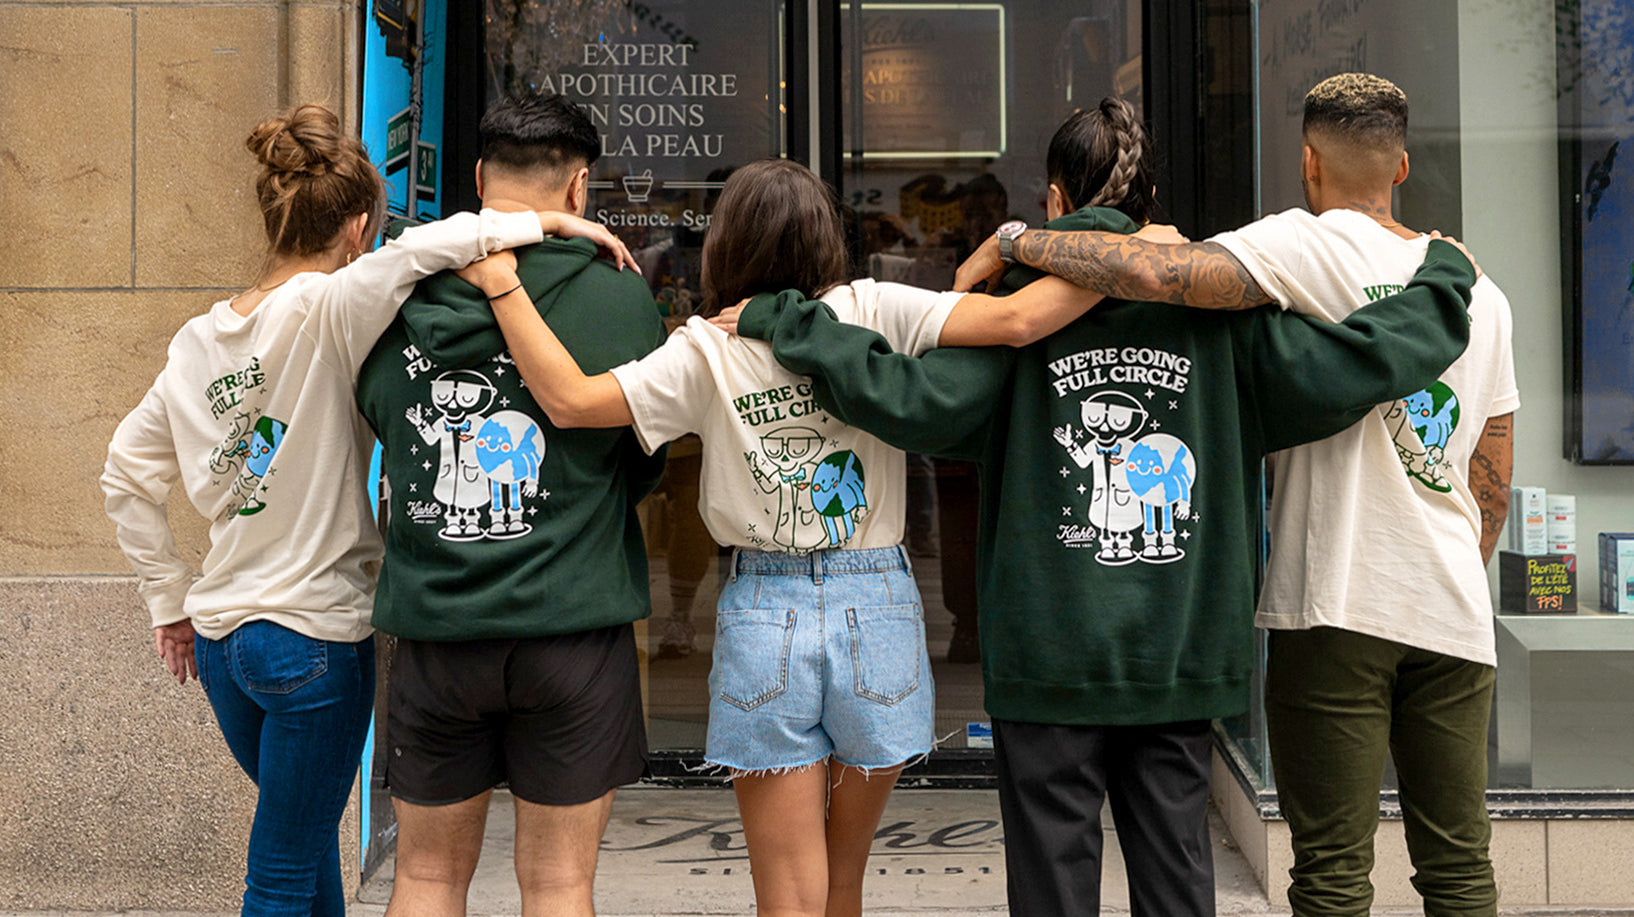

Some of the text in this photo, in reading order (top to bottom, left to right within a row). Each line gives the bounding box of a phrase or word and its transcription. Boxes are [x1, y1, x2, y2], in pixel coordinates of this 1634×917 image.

[583, 43, 694, 66] EXPERT
[536, 73, 738, 97] APOTHICAIRE
[618, 103, 705, 127] SOINS
[600, 134, 725, 157] LA PEAU
[596, 208, 713, 227] Science. Ser
[1362, 284, 1405, 301] WE'R
[1048, 346, 1192, 377] WE'RE GOING
[204, 370, 243, 402] WE'RE
[1052, 365, 1188, 398] FULL CIRCLE
[210, 391, 244, 420] FULL
[733, 385, 794, 413] WE'RE
[1529, 585, 1572, 595] AVEC NOS
[1531, 576, 1544, 585] DE
